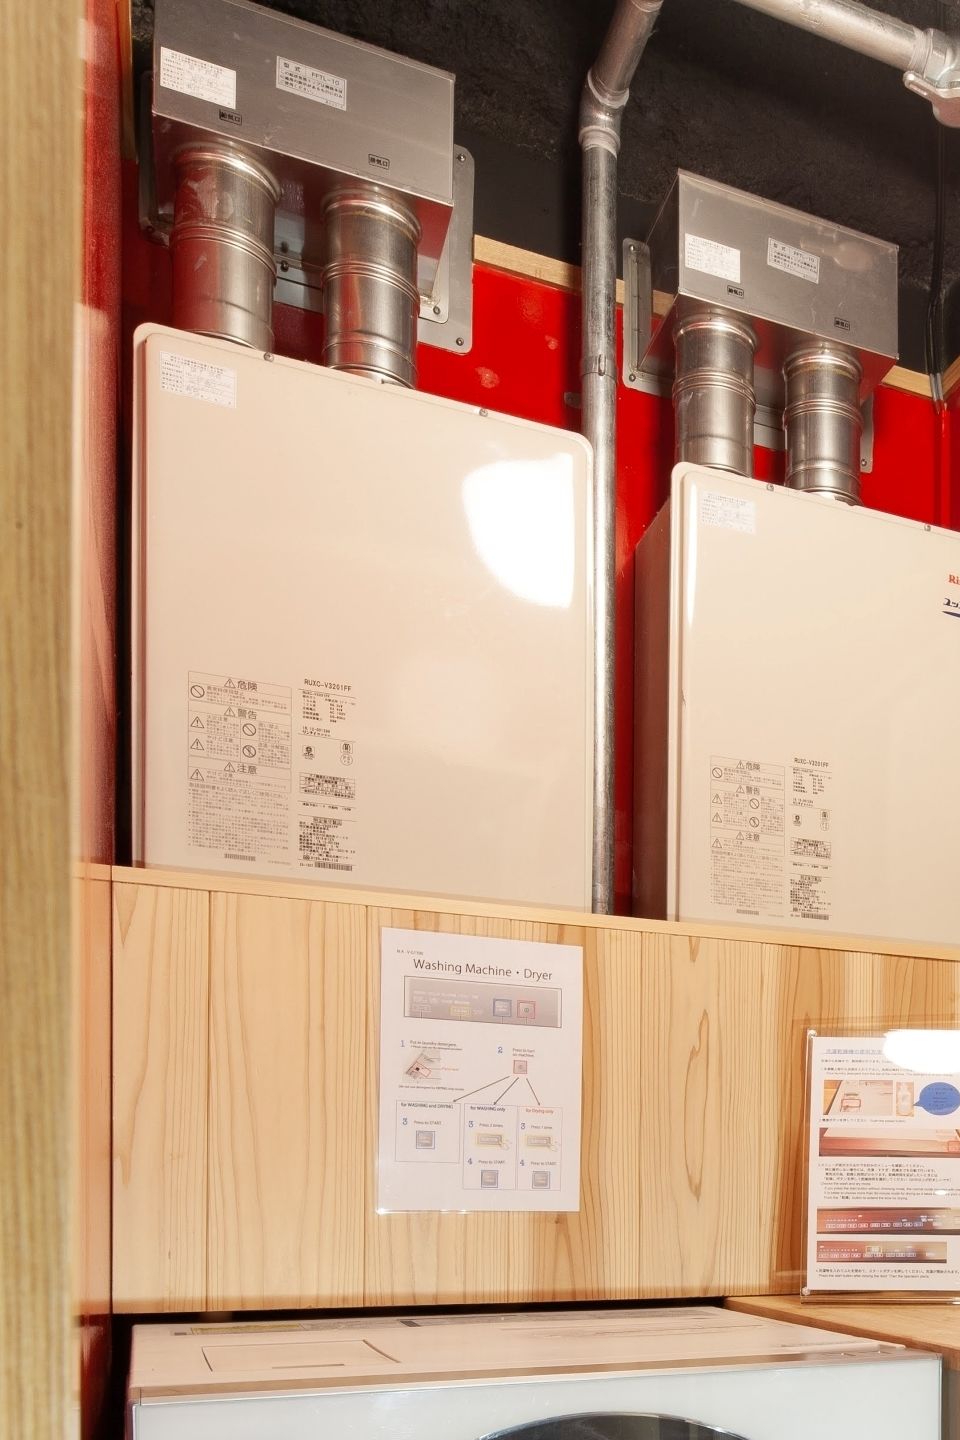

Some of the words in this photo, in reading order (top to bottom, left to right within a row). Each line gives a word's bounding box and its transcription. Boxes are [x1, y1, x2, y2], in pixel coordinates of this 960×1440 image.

[237, 679, 258, 692] 危険
[237, 707, 258, 721] 警告
[237, 763, 258, 775] 注意
[413, 958, 462, 975] Washing
[465, 963, 512, 977] Machine
[523, 968, 553, 982] Dryer
[497, 1046, 503, 1054] 2
[402, 1117, 408, 1126] 3
[468, 1120, 474, 1128] 3
[520, 1122, 526, 1130] 3
[467, 1157, 473, 1165] 4
[519, 1159, 525, 1167] 4
